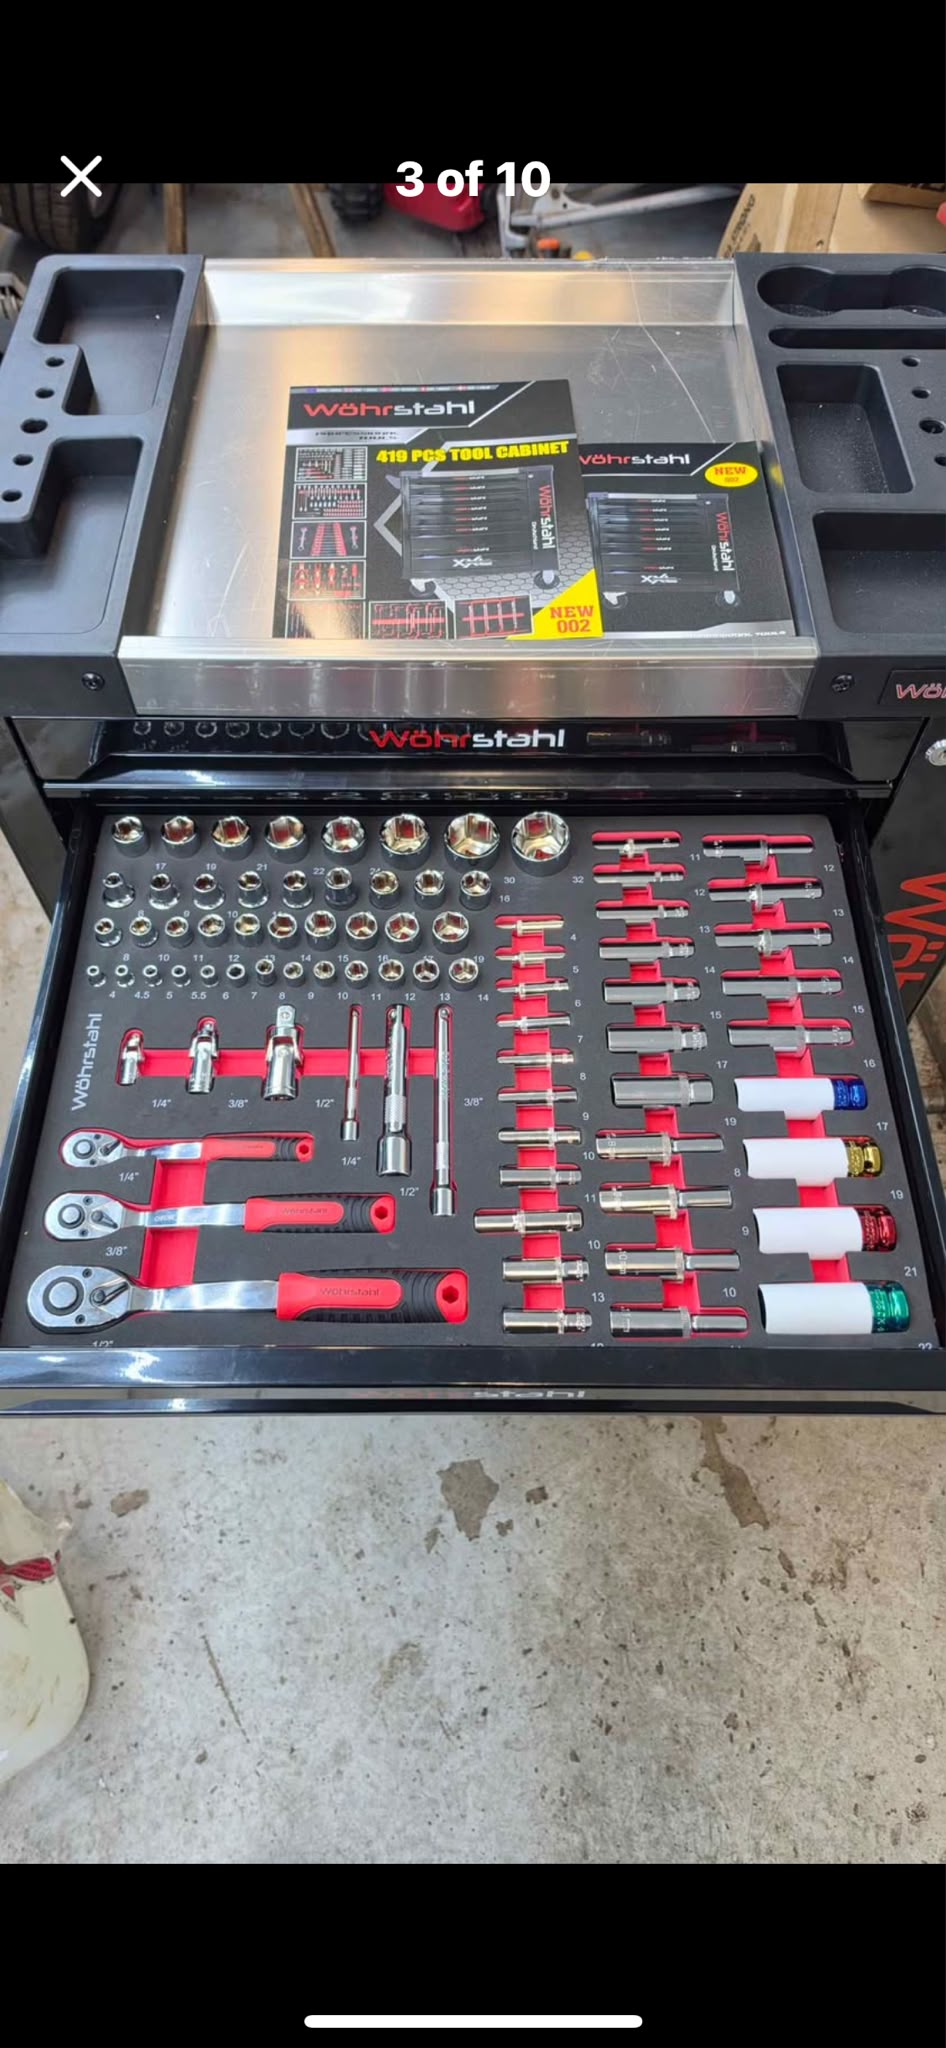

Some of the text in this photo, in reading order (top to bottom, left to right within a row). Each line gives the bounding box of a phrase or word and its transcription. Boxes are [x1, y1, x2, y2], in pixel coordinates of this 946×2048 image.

[303, 400, 475, 417] Wöhrstahl
[376, 441, 569, 463] 419 PCS TOOL CABINET
[715, 467, 746, 475] NEW
[539, 484, 556, 549] Wöhrstahl
[716, 512, 735, 571] Wöhrstahl
[550, 605, 594, 619] NEW
[557, 619, 591, 634] 002
[369, 729, 565, 748] Wöhrstahl
[313, 868, 325, 876] 22
[123, 953, 130, 961] 8
[135, 991, 150, 999] 4.5
[166, 991, 172, 999] 5
[279, 992, 285, 1000] 8
[338, 992, 348, 1000] 10
[710, 1011, 722, 1019] 15
[578, 1035, 583, 1043] 7
[71, 1013, 103, 1111] Wöhrstahl
[864, 1059, 876, 1067] 16
[153, 1099, 171, 1107] 1/4"
[228, 1100, 248, 1108] 3/8"
[316, 1099, 334, 1107] 1/2"
[464, 1098, 483, 1106] 3/8"
[583, 1112, 589, 1120] 9
[725, 1117, 736, 1126] 19
[877, 1122, 888, 1130] 17
[584, 1152, 595, 1160] 10
[342, 1157, 361, 1165] 1/4"
[120, 1172, 139, 1181] 1/4"
[734, 1168, 741, 1177] 8
[400, 1187, 419, 1196] 1/2"
[891, 1190, 903, 1199] 19
[585, 1194, 595, 1202] 11
[742, 1226, 749, 1235] 9
[588, 1240, 600, 1249] 10
[106, 1246, 127, 1256] 3/8"
[904, 1266, 917, 1276] 21
[723, 1287, 736, 1297] 10
[592, 1292, 605, 1302] 13
